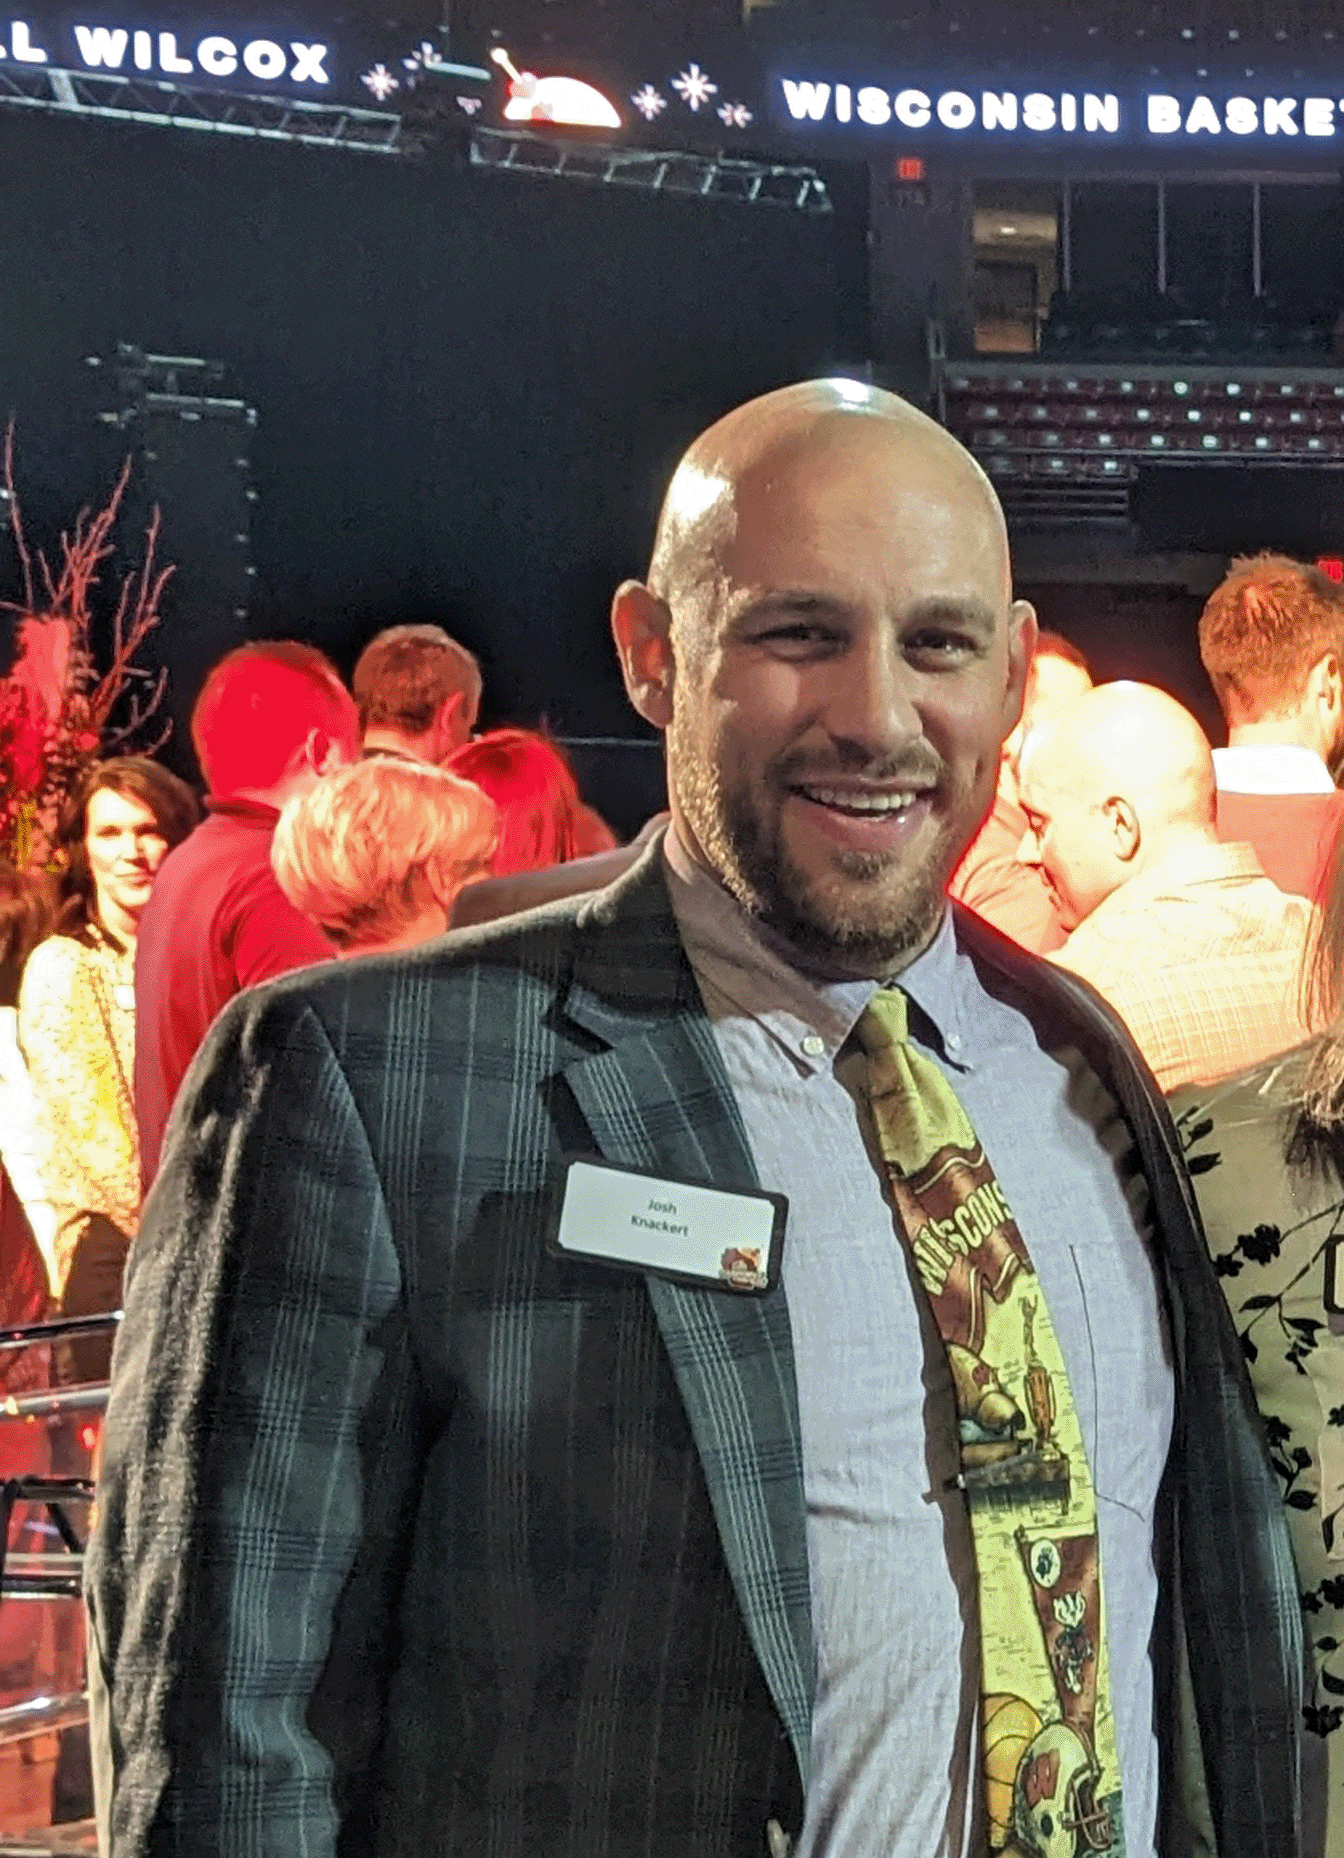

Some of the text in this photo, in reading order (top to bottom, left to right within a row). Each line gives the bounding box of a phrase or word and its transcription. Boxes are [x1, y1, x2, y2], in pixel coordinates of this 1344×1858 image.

[74, 25, 329, 84] WILCOX
[783, 80, 1119, 133] WISCONSIN
[647, 1199, 678, 1215] Josh
[631, 1215, 689, 1237] Knackert
